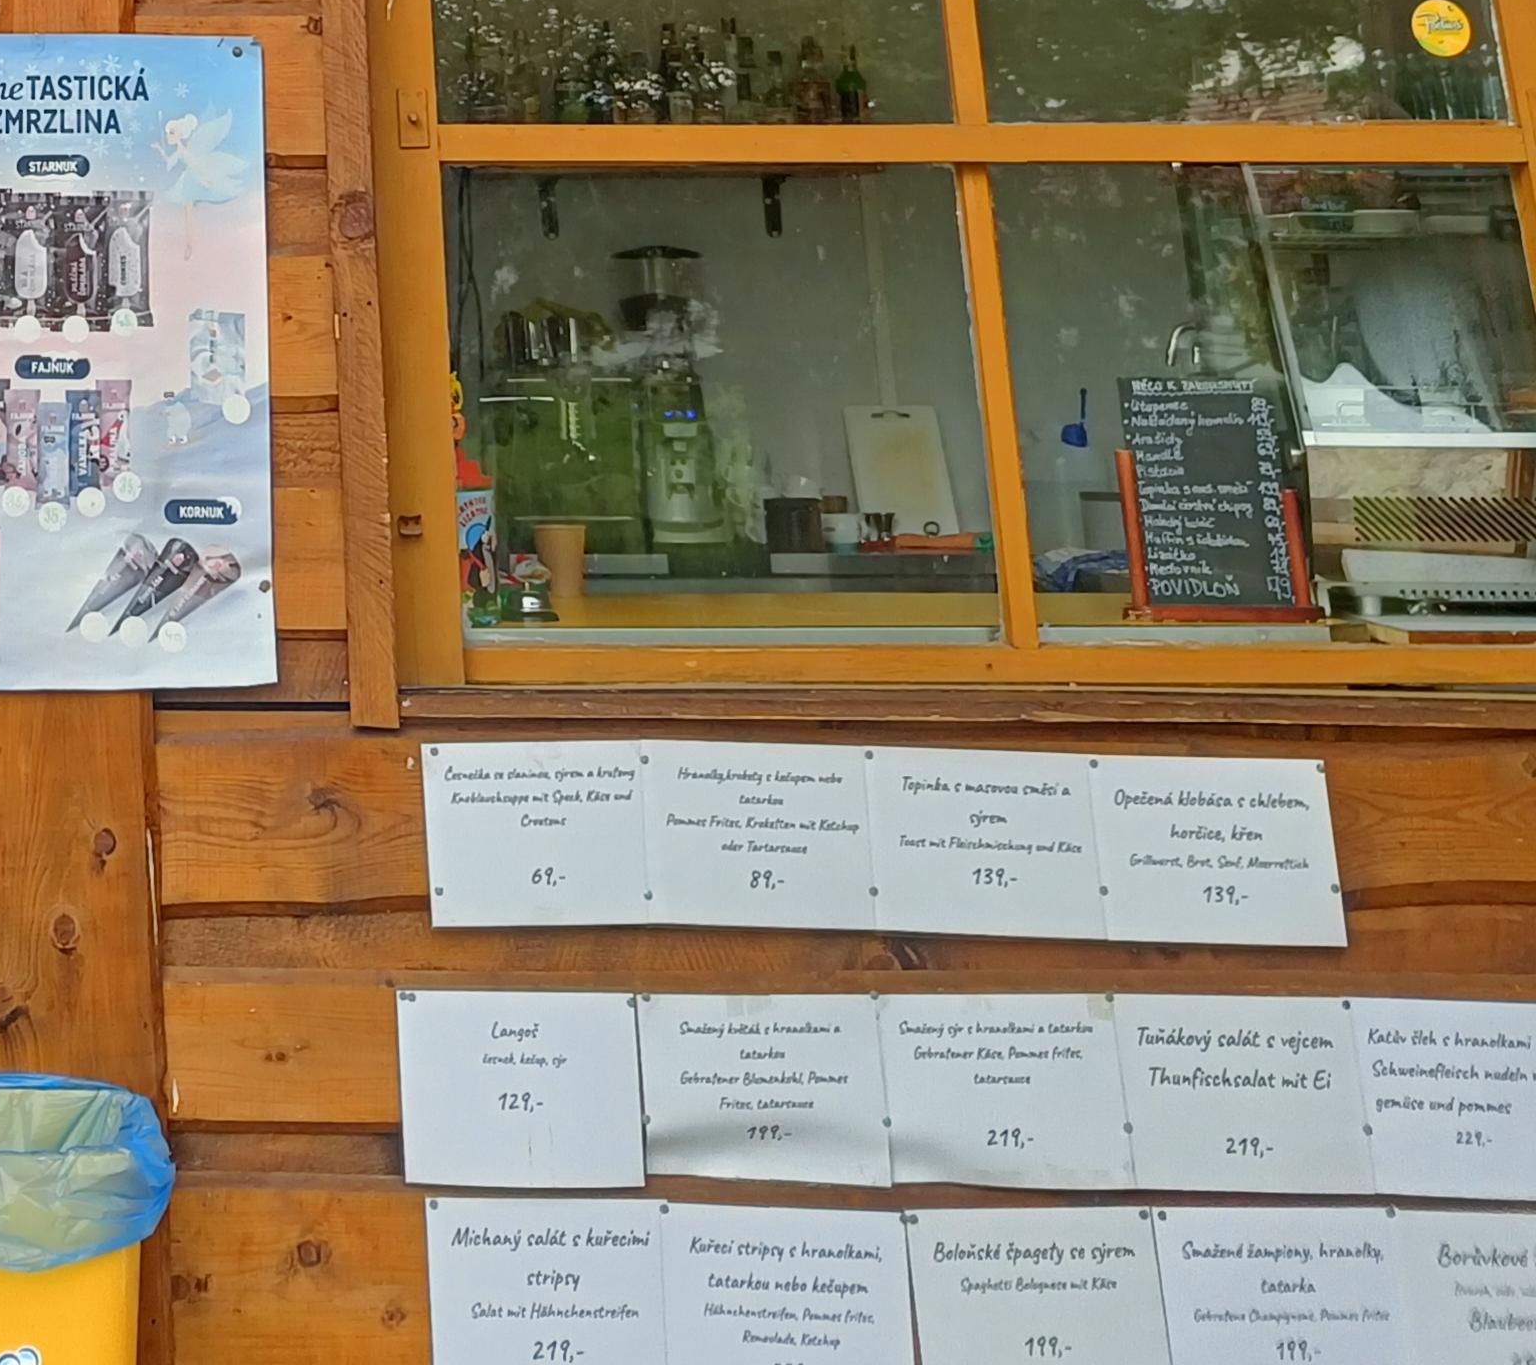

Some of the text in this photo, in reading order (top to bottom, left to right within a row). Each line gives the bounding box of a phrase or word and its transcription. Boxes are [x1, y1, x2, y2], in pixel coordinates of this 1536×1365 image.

[27, 160, 78, 173] STARNUK
[902, 776, 950, 794] Topinka
[1114, 789, 1310, 810] Opečená klobása s chlebem,
[1170, 824, 1263, 842] horčice, křen
[531, 867, 566, 886] 69,-
[750, 870, 784, 890] 89,-
[972, 868, 1018, 888] 139,-
[1203, 886, 1248, 906] 139,-
[491, 1021, 540, 1042] Langoš
[1137, 1026, 1333, 1055] Tuňákový salát s vejcem
[1443, 1036, 1450, 1046] s
[1149, 1067, 1332, 1090] Thunfischsalat mit Ei
[498, 1092, 544, 1113] 129,-
[747, 1125, 792, 1141] 199,-
[987, 1128, 1034, 1149] 219,-
[1226, 1137, 1274, 1158] 219,-
[451, 1227, 650, 1252] Michaný salát s kuřecími
[689, 1237, 734, 1254] Kuřecí
[738, 1242, 784, 1262] stripsy
[789, 1246, 796, 1258] s
[933, 1242, 1135, 1266] Boloňské špagety se sýrem
[1182, 1240, 1244, 1260] Smažené
[1247, 1244, 1313, 1264] žampiony,
[527, 1270, 581, 1292] stripsy
[708, 1273, 869, 1299] tatarkou nebo kečupem
[1261, 1277, 1316, 1294] tatarka
[471, 1303, 503, 1320] Salat
[507, 1306, 526, 1318] mit
[533, 1339, 584, 1363] 219,-
[1024, 1336, 1072, 1359] 199,-
[1276, 1340, 1322, 1362] 199,-
